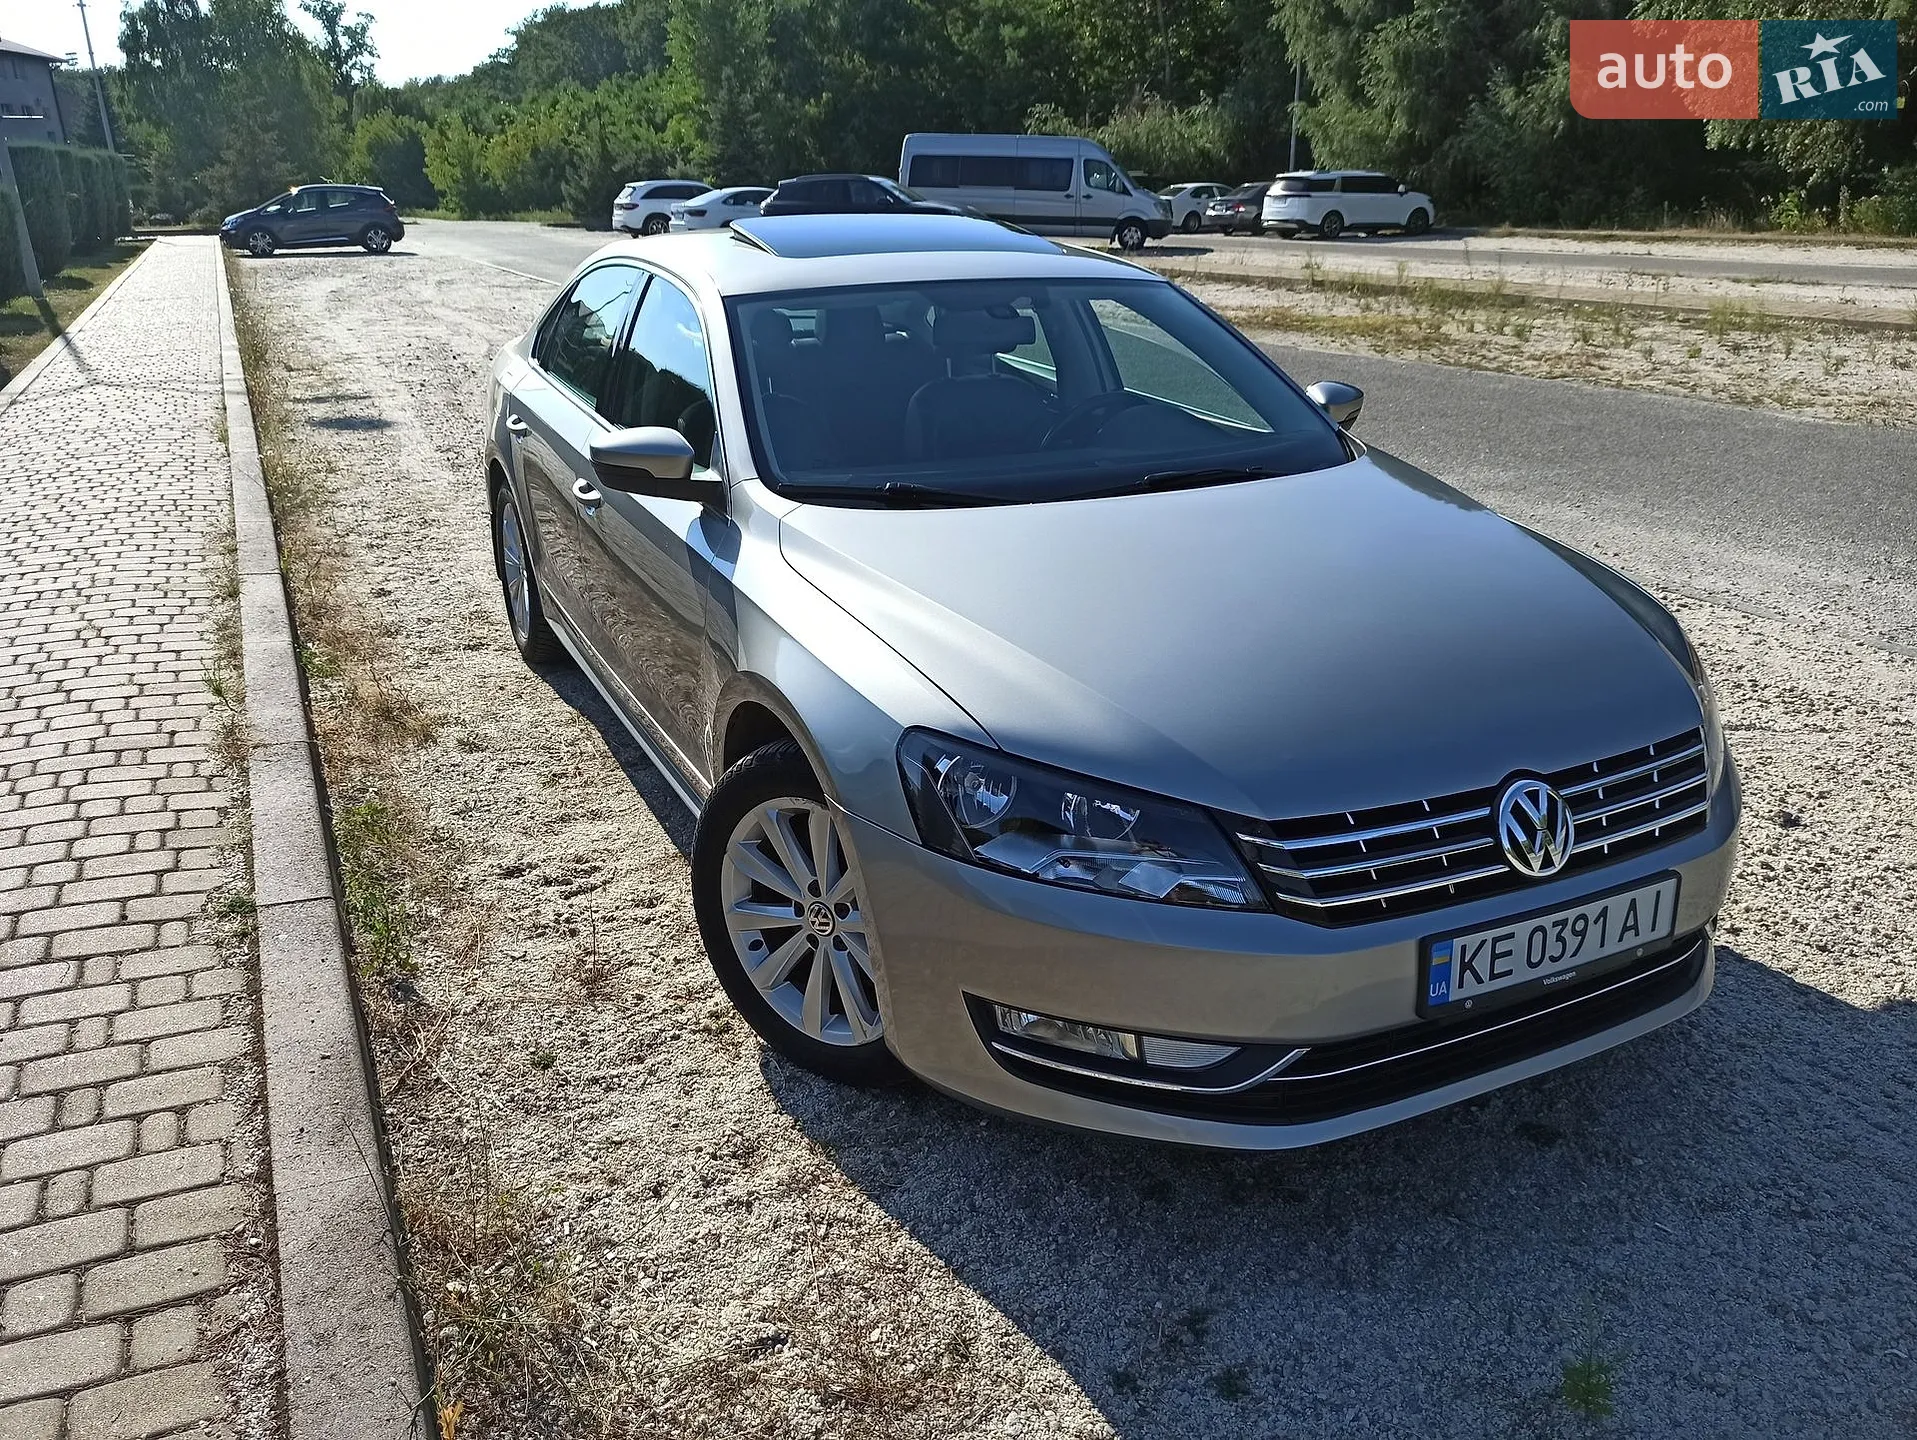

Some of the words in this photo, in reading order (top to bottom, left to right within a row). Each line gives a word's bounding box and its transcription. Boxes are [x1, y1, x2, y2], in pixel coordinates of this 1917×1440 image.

[1457, 931, 1516, 989] KE
[1525, 905, 1609, 970] 0391
[1617, 890, 1662, 943] AI
[1429, 981, 1448, 998] UA
